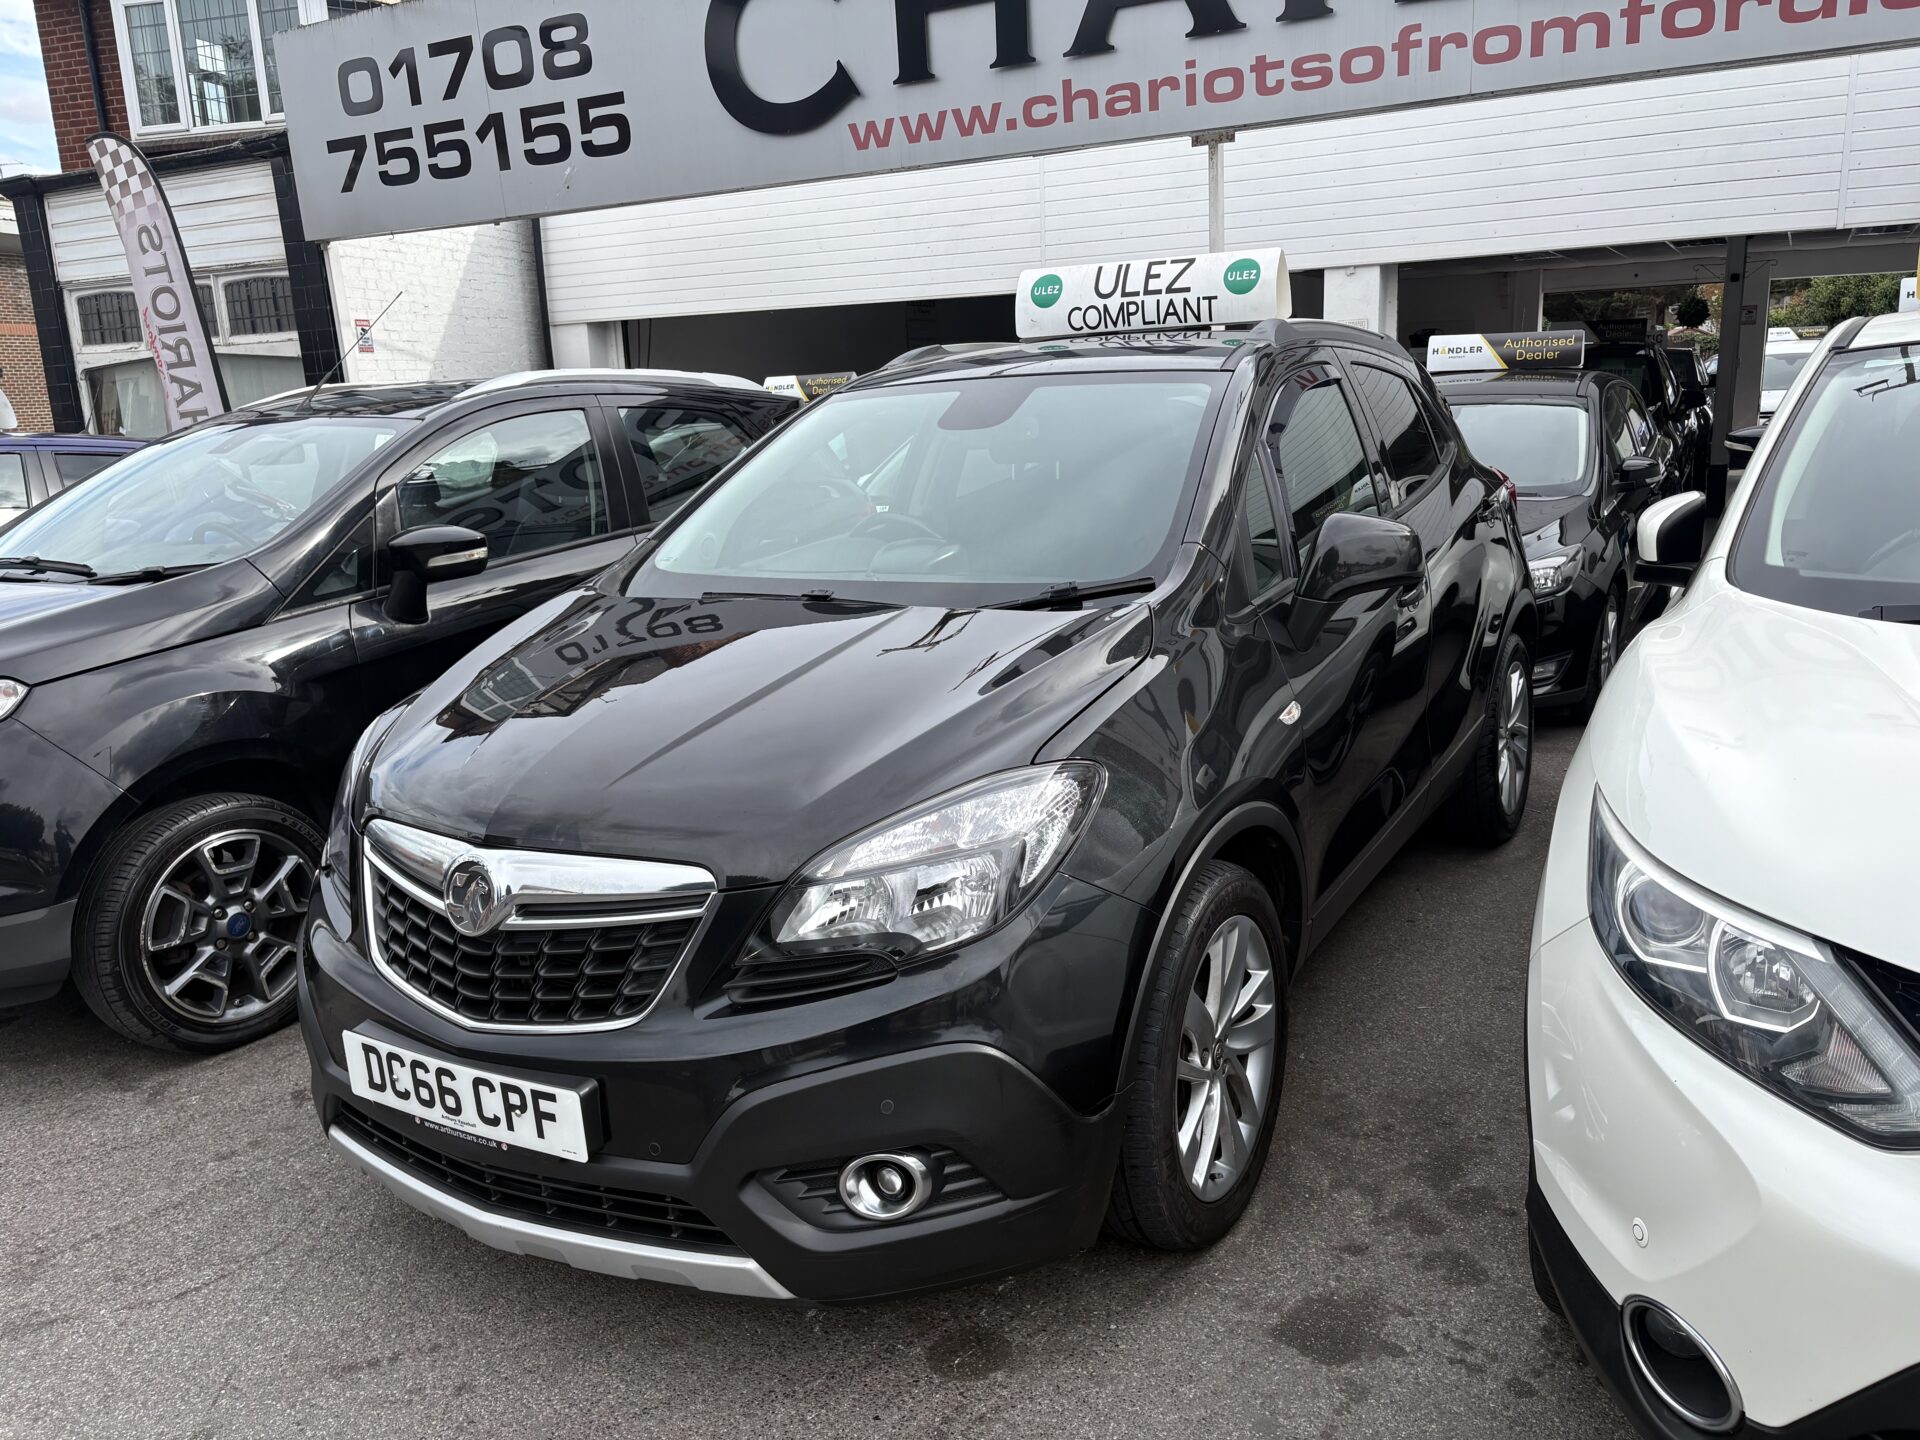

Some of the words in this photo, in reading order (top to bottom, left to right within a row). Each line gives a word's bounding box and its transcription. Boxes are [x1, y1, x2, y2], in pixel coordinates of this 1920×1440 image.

[337, 12, 593, 117] 01708
[326, 90, 631, 193] 755155
[1093, 257, 1196, 299] ULEZ
[1227, 269, 1257, 281] ULEZ
[1034, 284, 1060, 296] ULEZ
[1067, 295, 1218, 331] COMPLIANT
[1503, 334, 1575, 348] Authorised
[1516, 349, 1560, 361] Dealer
[806, 376, 847, 386] Authorised
[361, 1042, 462, 1117] DC66
[472, 1076, 557, 1140] CPF
[423, 1120, 498, 1149] www.arthurscars.co.uk
